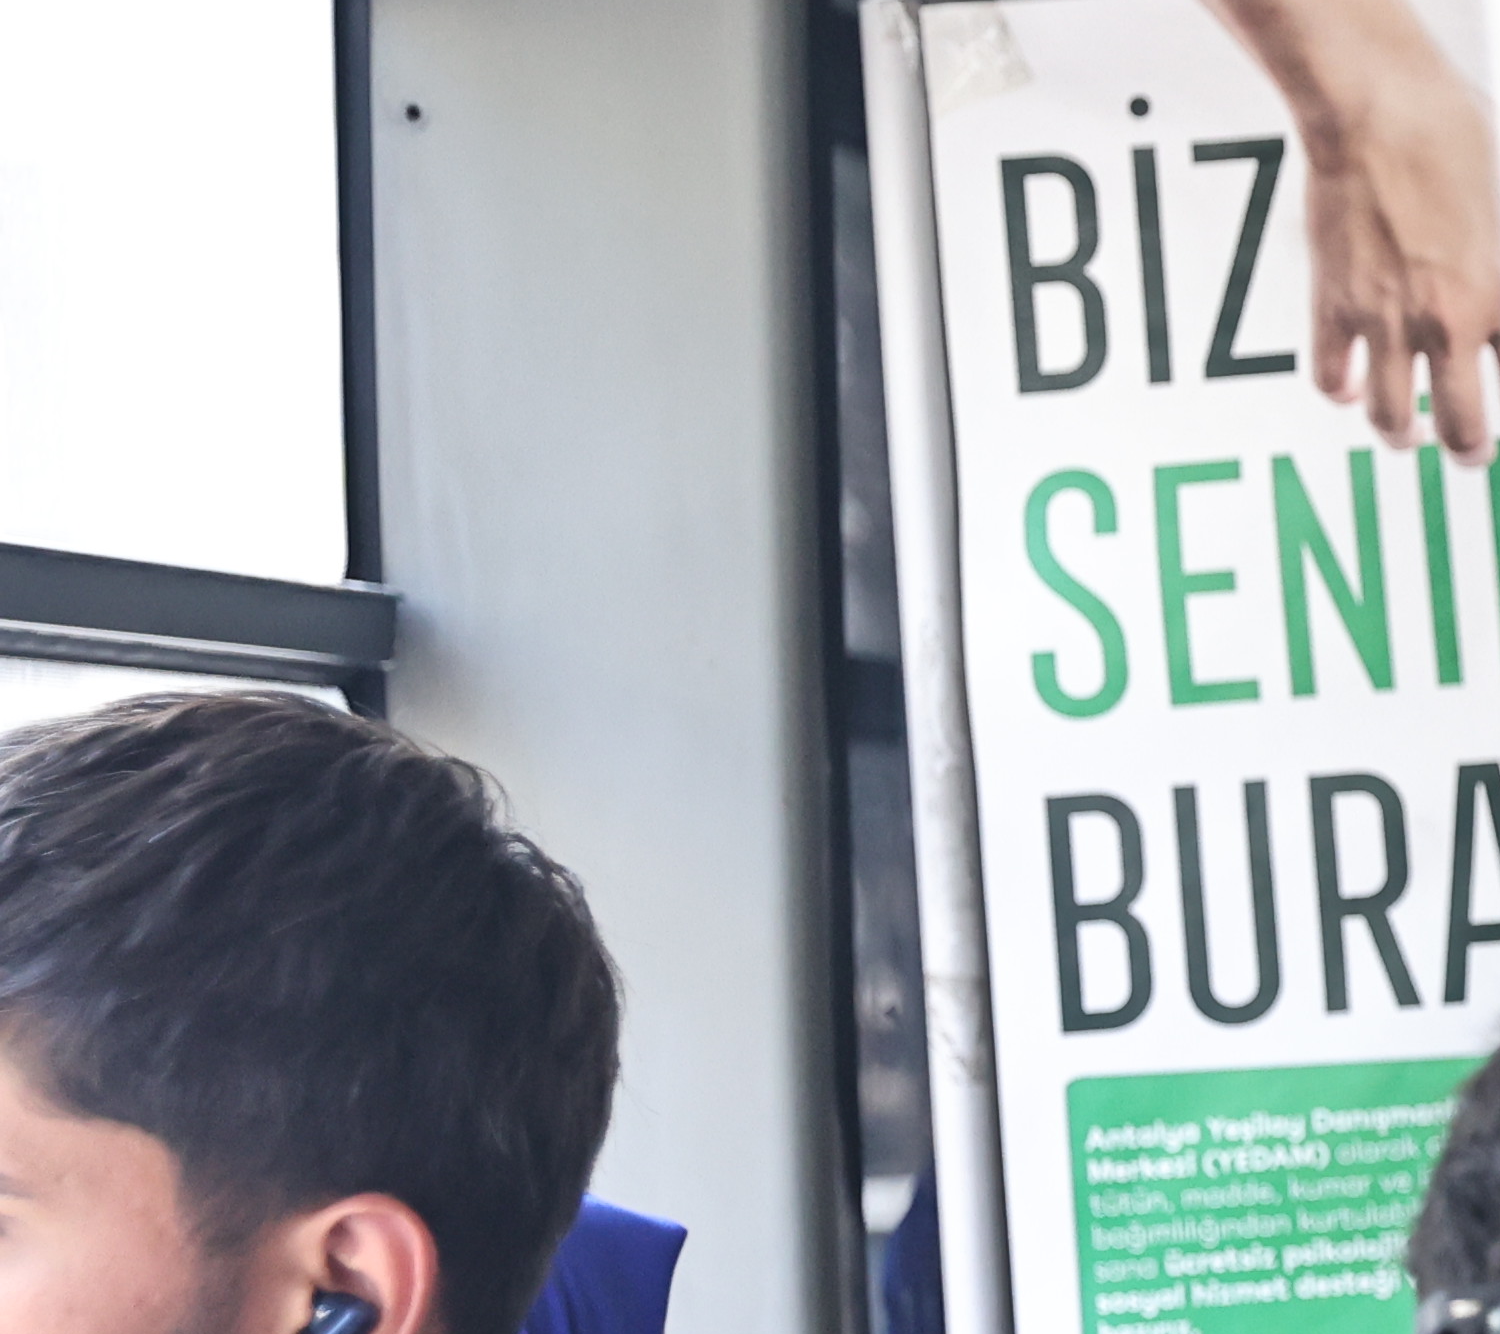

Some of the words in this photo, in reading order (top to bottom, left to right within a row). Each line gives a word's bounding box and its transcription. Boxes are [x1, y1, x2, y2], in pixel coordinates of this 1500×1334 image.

[999, 95, 1298, 394] BİZ
[1085, 1119, 1201, 1154] Antalya
[1204, 1110, 1306, 1146] Yeşilay
[1086, 1149, 1197, 1185] Merkezi
[1201, 1140, 1331, 1179] (YEDAM)
[1334, 1133, 1420, 1165] olarak
[1095, 1281, 1186, 1319] sosyal
[1190, 1273, 1290, 1309] hizmet
